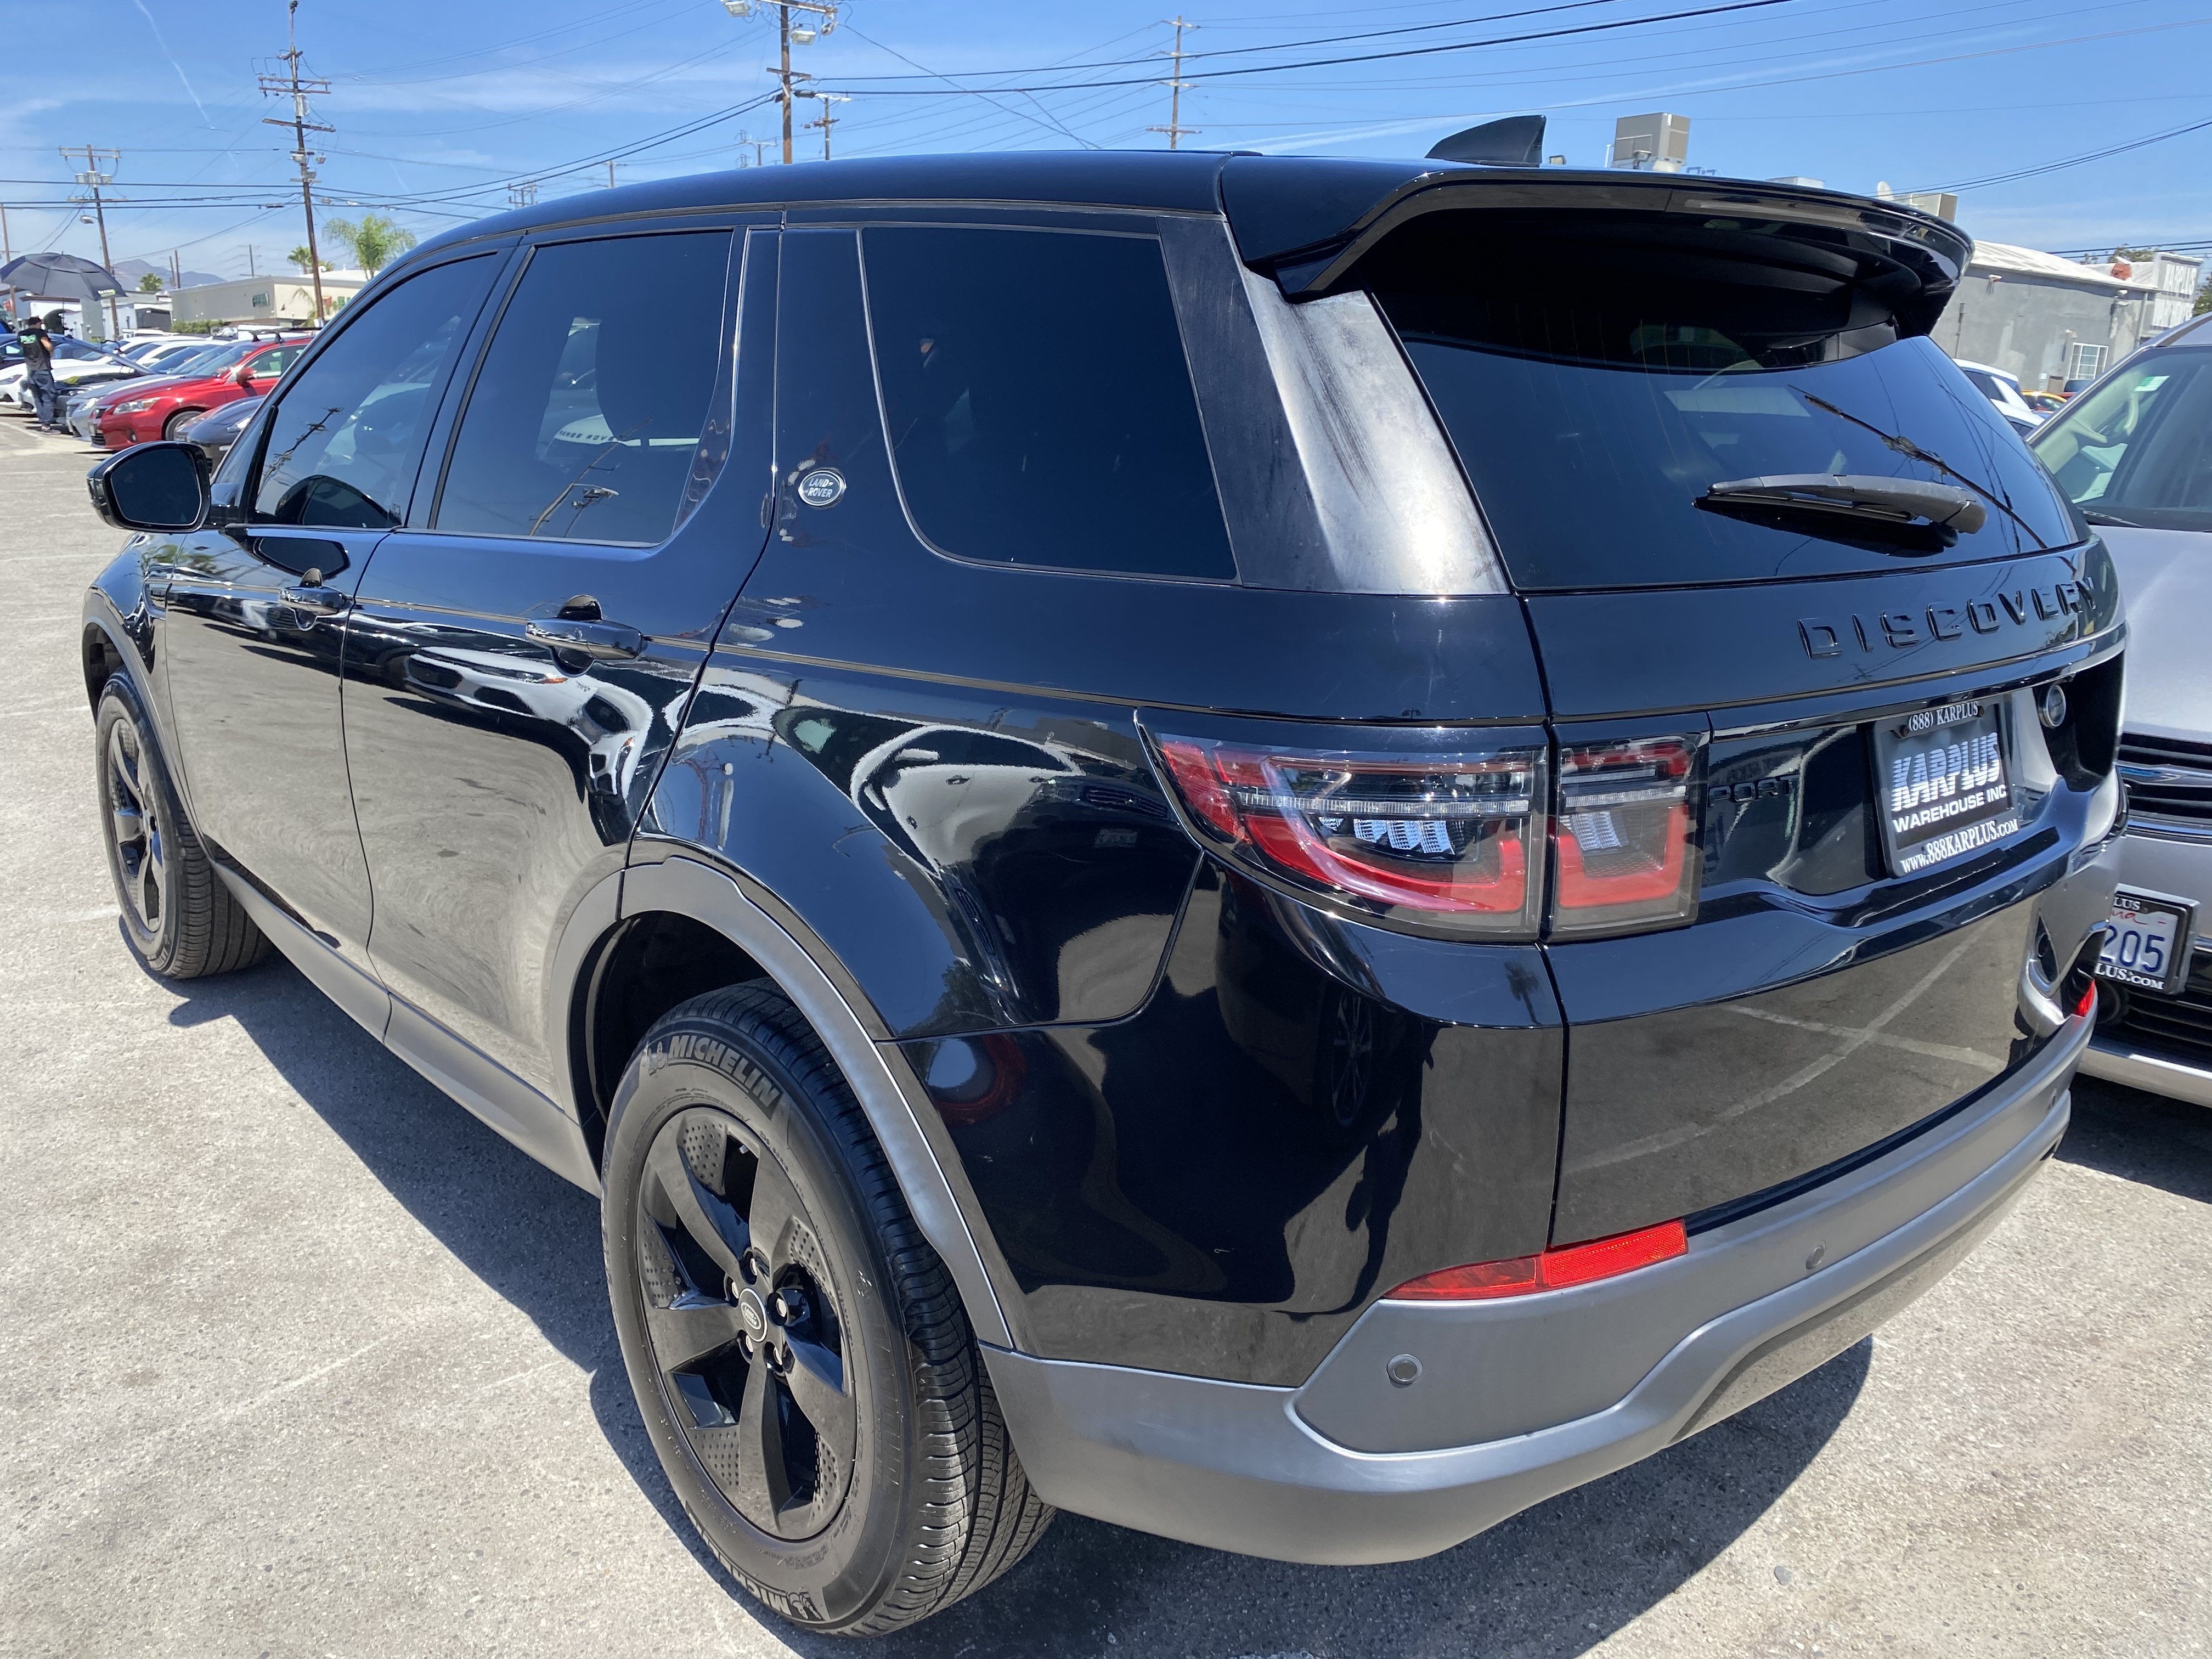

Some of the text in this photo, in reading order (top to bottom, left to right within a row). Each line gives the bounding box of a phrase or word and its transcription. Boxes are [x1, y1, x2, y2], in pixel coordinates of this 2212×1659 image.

[808, 488, 833, 498] ROVER
[809, 478, 830, 488] LAND
[1797, 577, 2096, 659] DISCOVERY
[1909, 701, 1978, 732] (888) KARPLUS
[1891, 732, 2001, 812] KARPLUS
[1893, 784, 2007, 833] WAREHOUSE INC
[668, 1035, 780, 1105] MICHELIN
